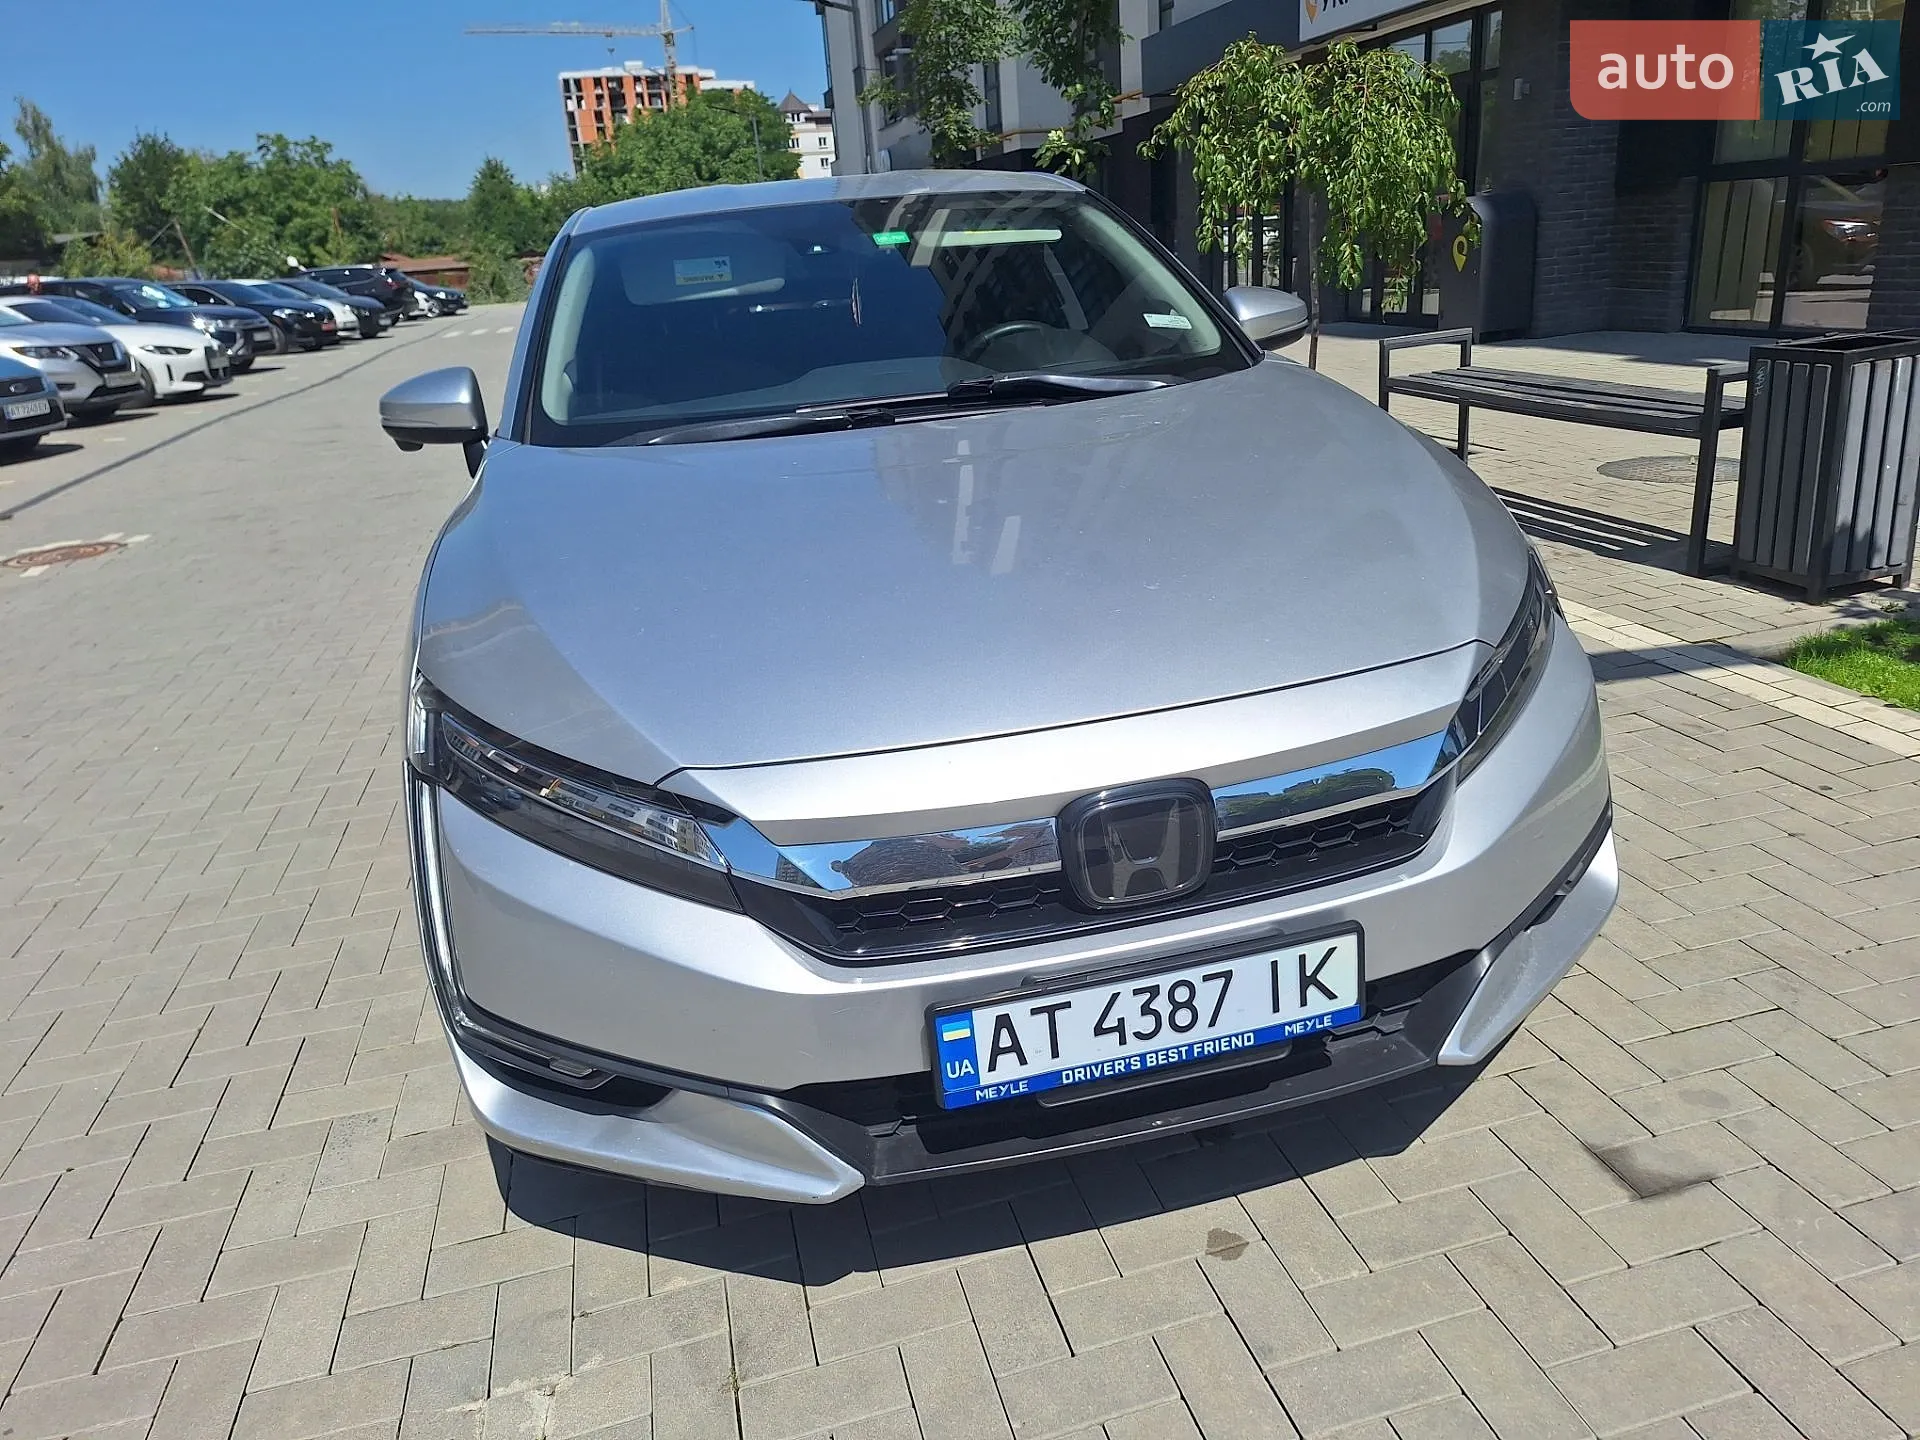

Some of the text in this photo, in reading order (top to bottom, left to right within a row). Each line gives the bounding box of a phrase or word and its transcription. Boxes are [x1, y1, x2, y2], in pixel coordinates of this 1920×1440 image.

[987, 945, 1338, 1073] AT 4387 IK
[1284, 1014, 1332, 1037] MEYLE
[946, 1059, 975, 1079] UA
[1062, 1032, 1255, 1085] DRIVER'S BEST FRIEND
[975, 1079, 1029, 1101] MEYLE
